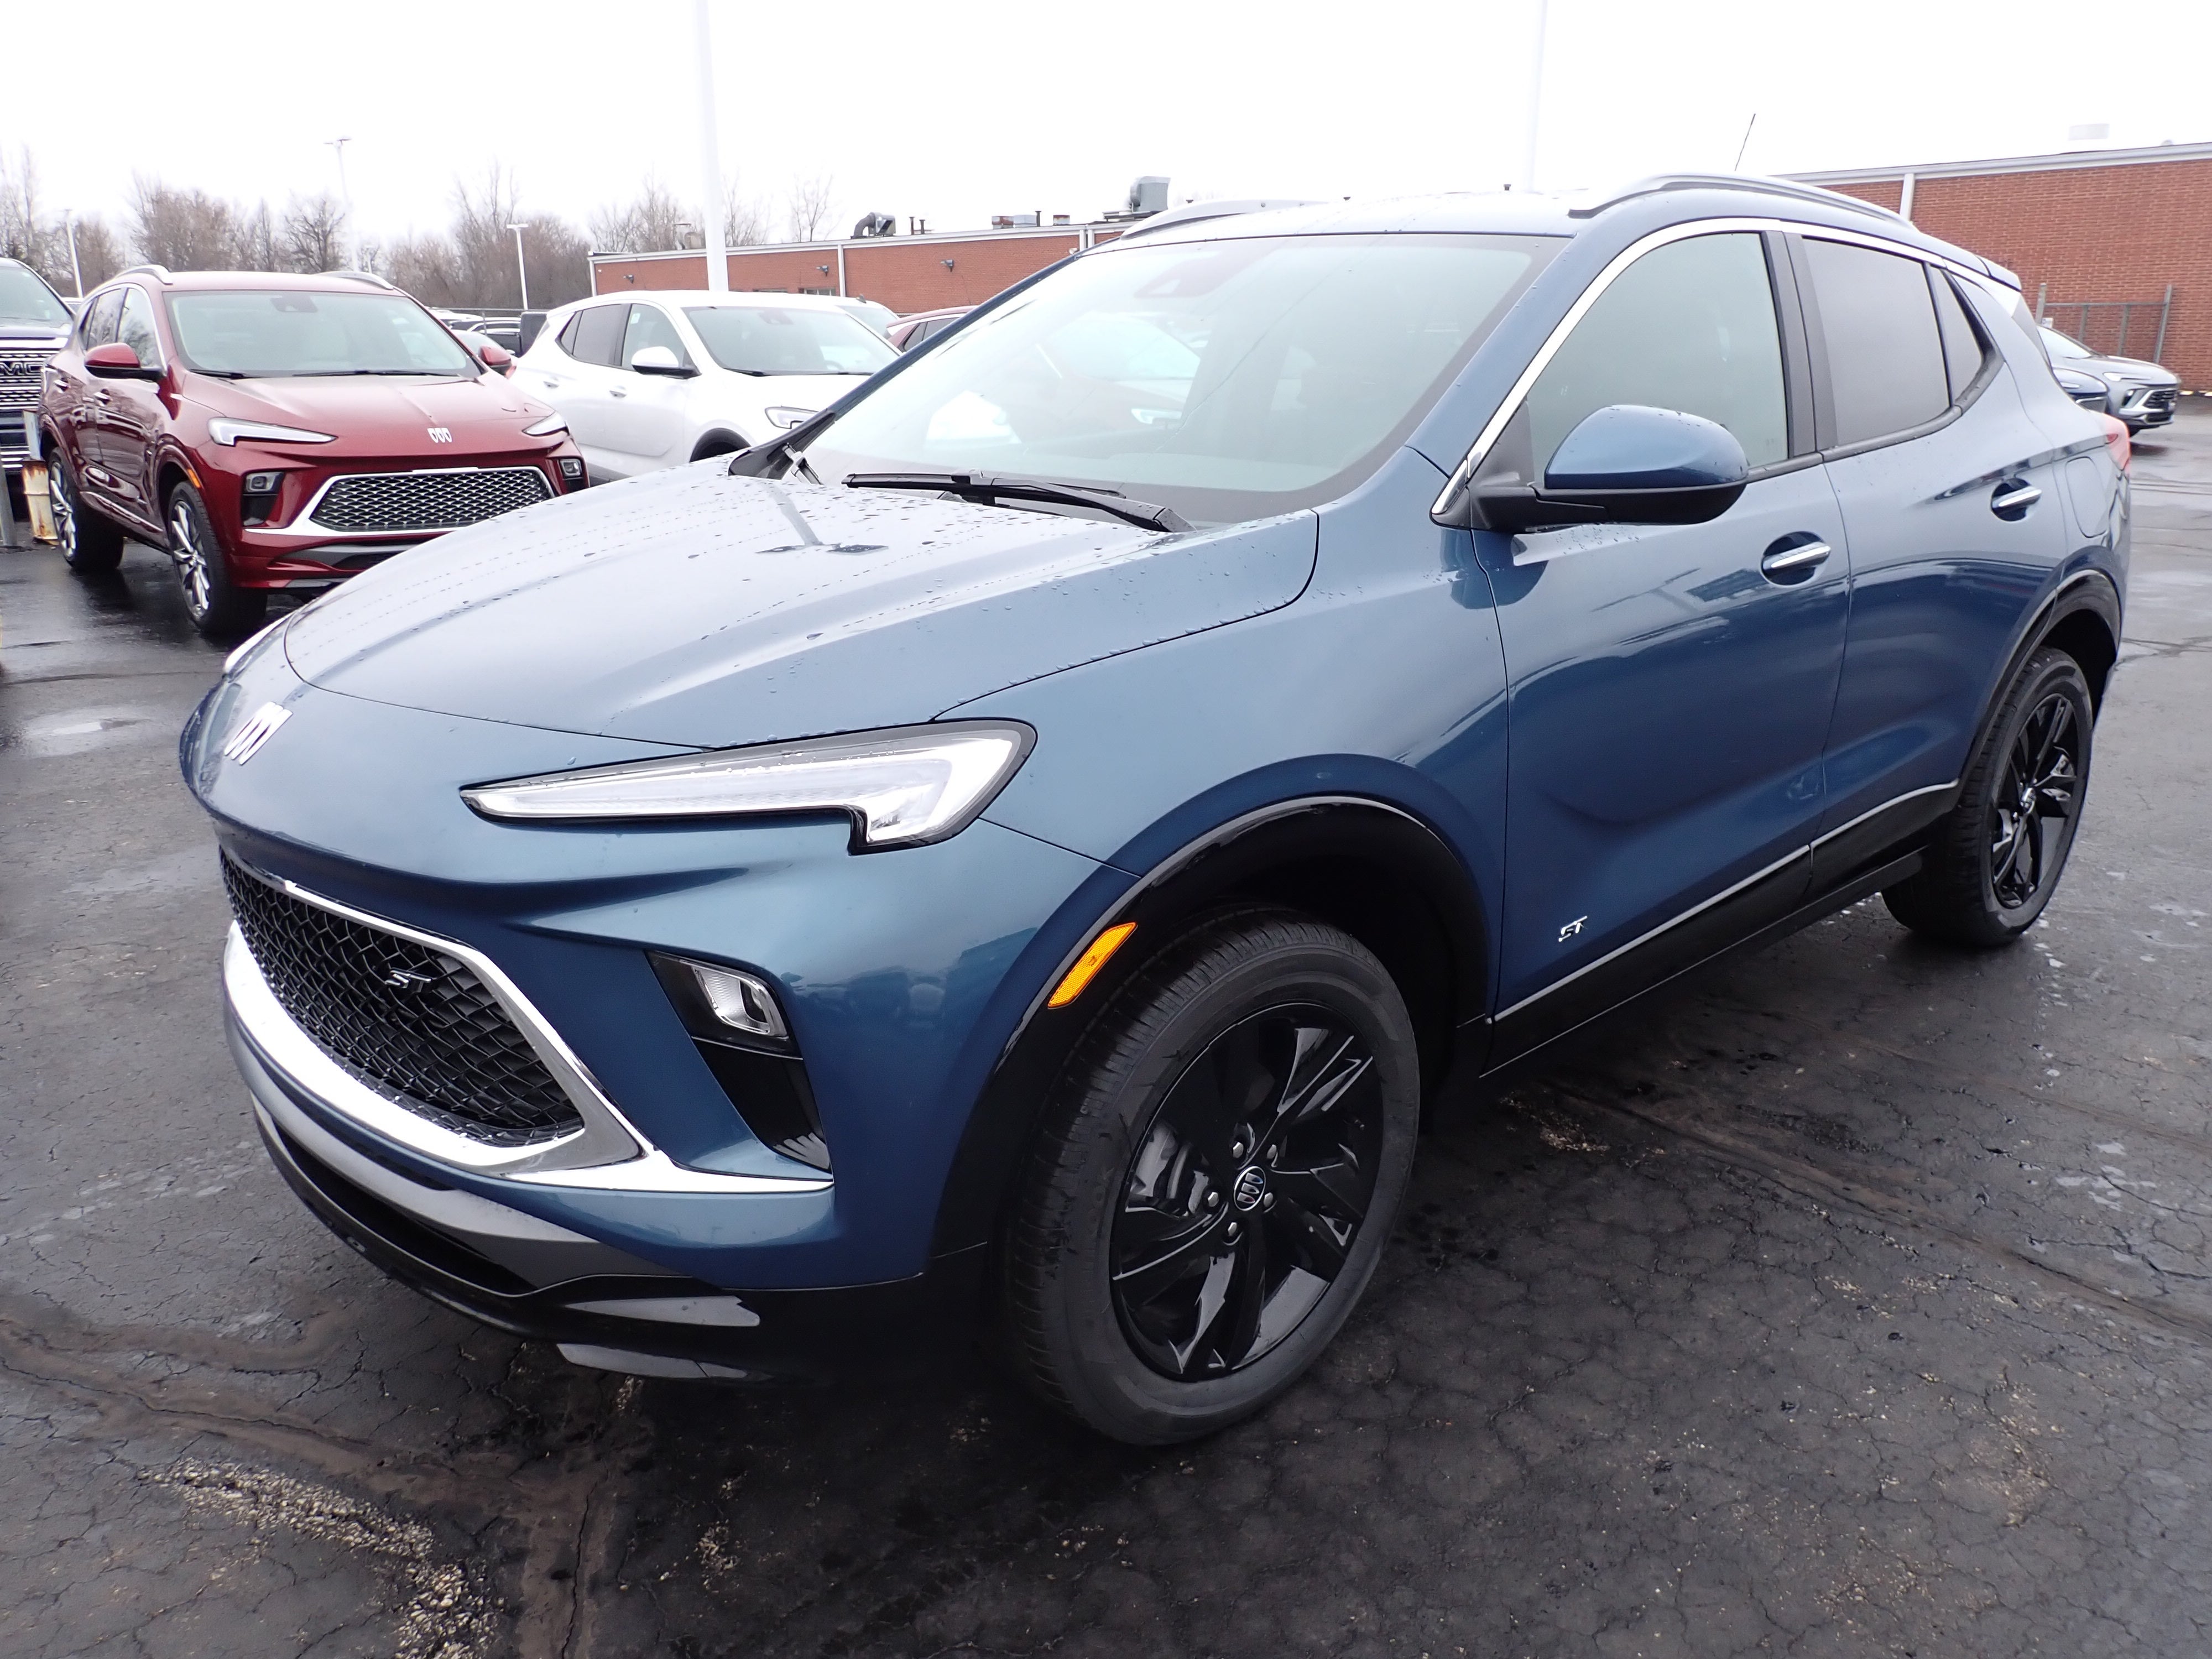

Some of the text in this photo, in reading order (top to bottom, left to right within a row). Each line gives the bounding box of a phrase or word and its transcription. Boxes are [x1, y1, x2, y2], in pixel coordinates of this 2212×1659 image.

[0, 362, 43, 375] MC
[1558, 915, 1588, 942] ST
[384, 969, 432, 993] ST
